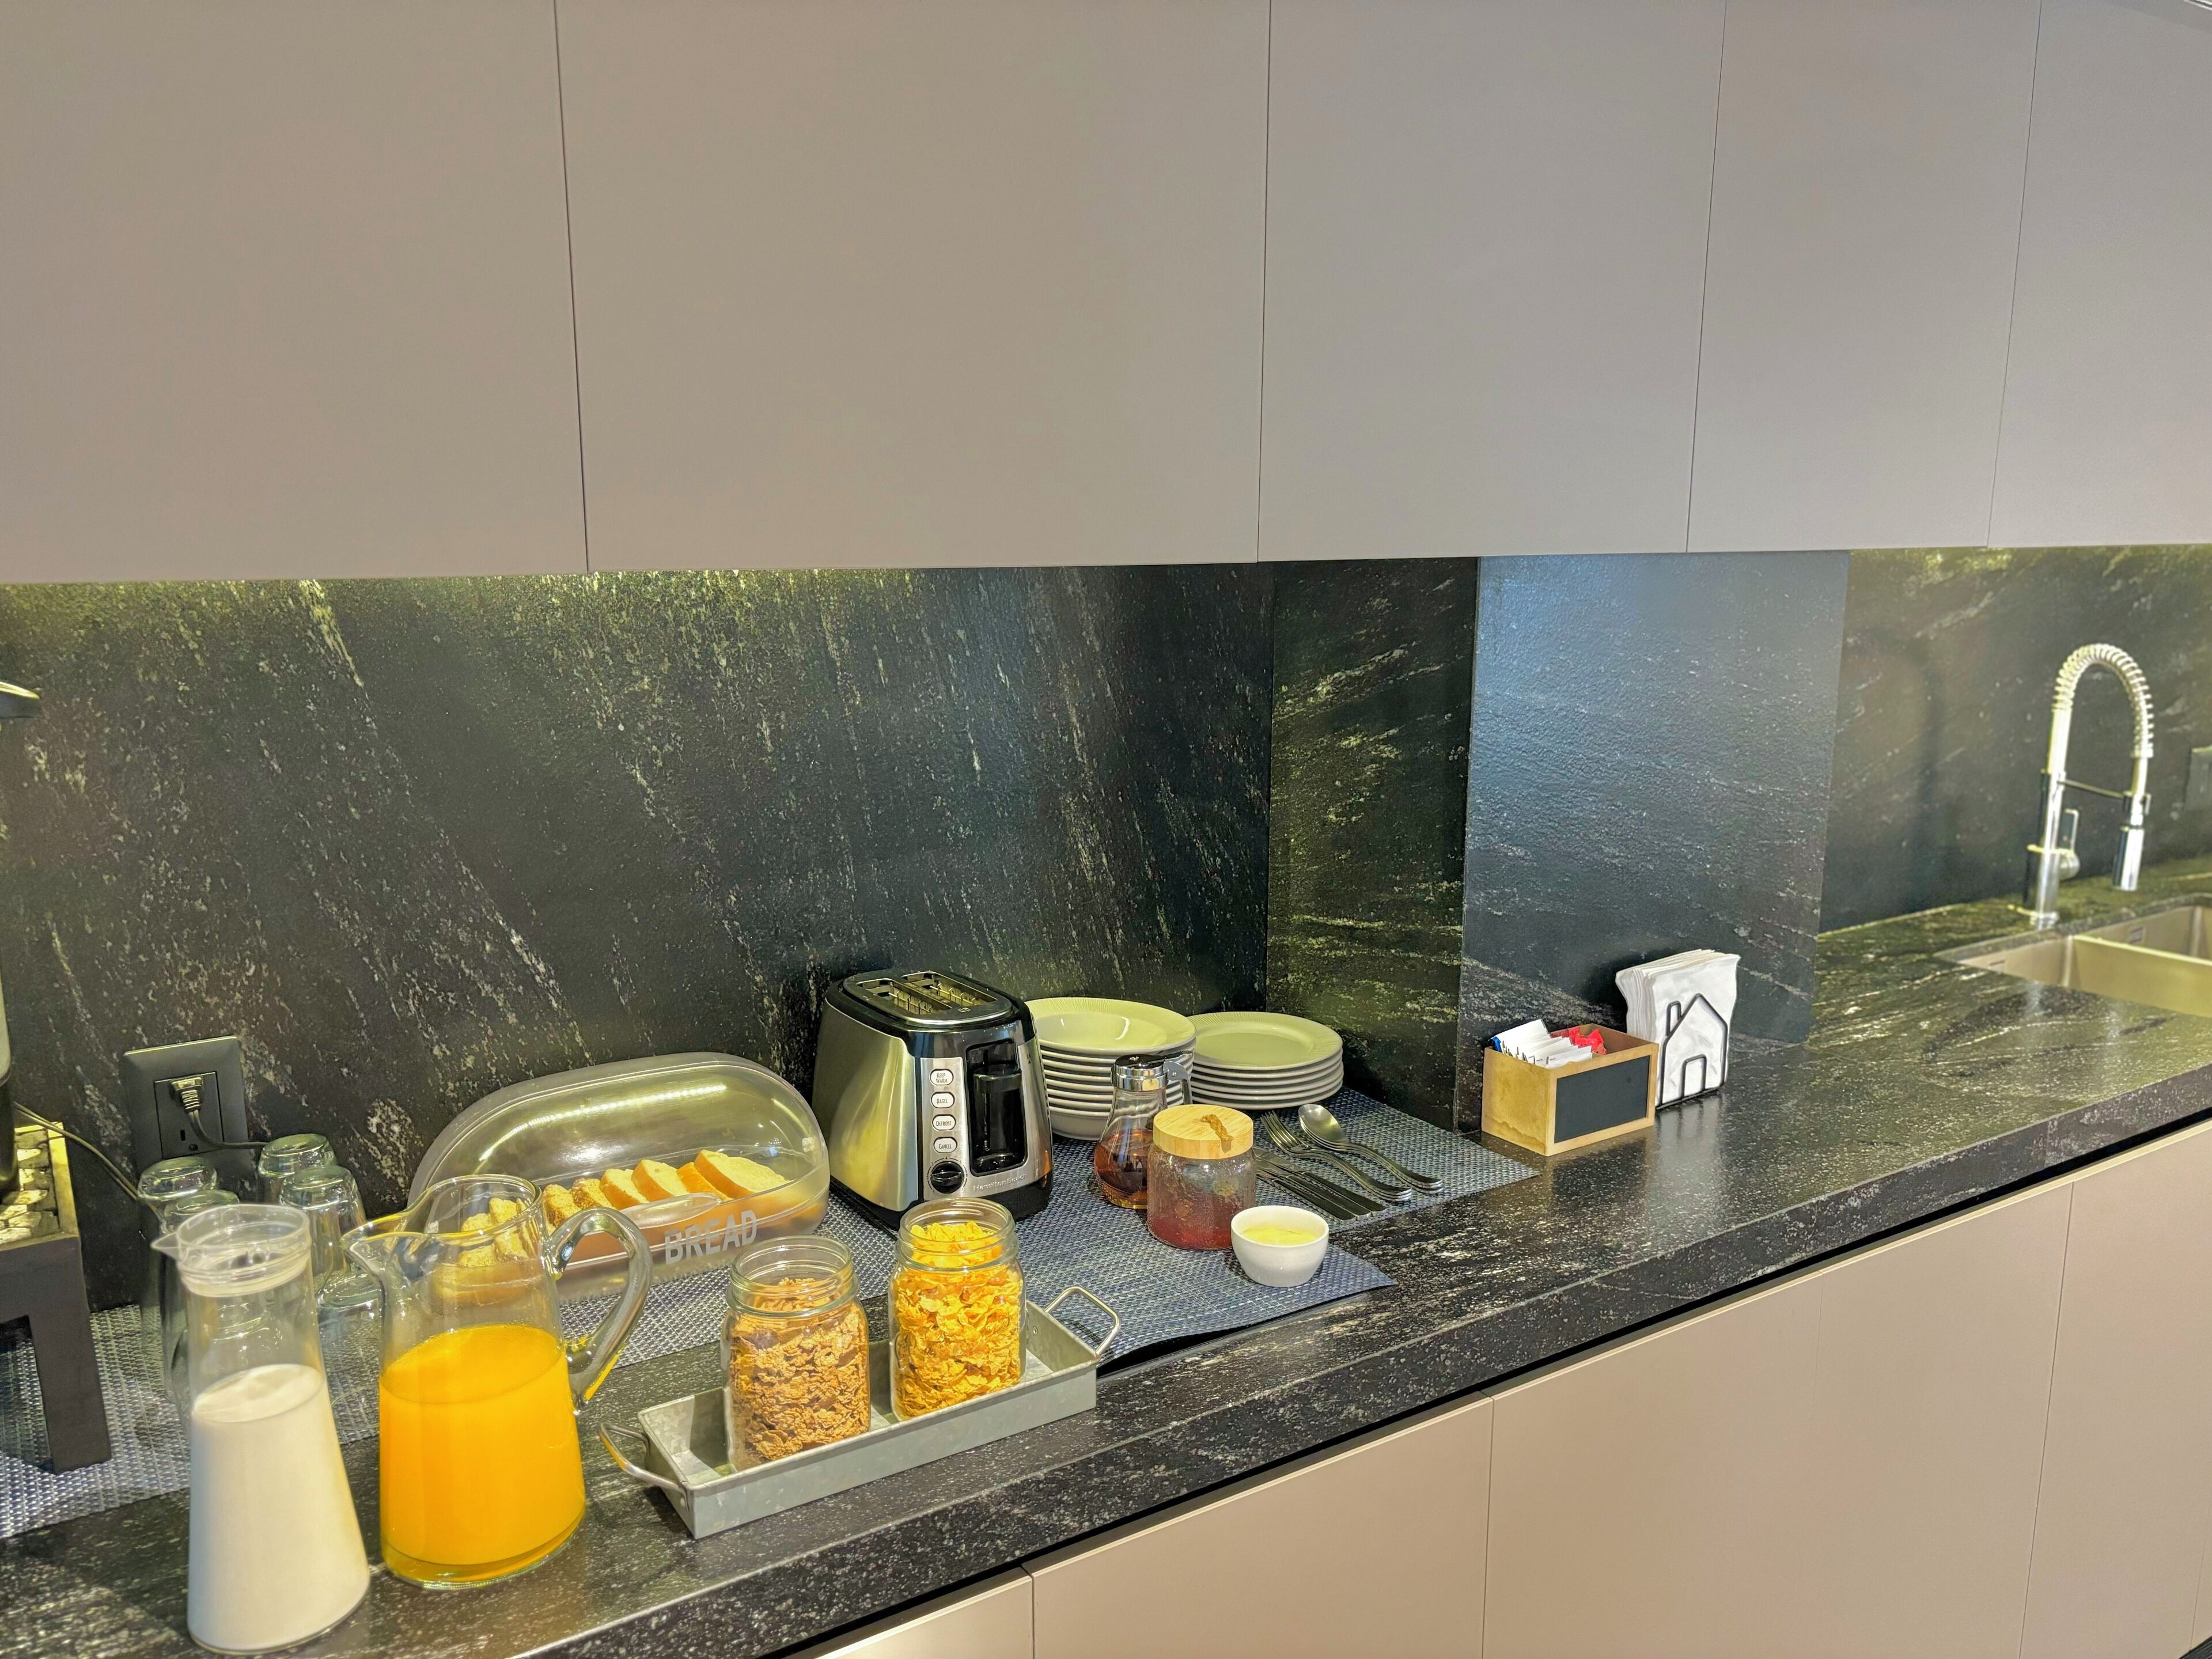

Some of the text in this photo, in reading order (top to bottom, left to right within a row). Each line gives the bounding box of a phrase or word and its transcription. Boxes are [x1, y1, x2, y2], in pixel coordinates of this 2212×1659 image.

[973, 1173, 1027, 1192] Hamilton Beach
[664, 1210, 757, 1265] BREAD
